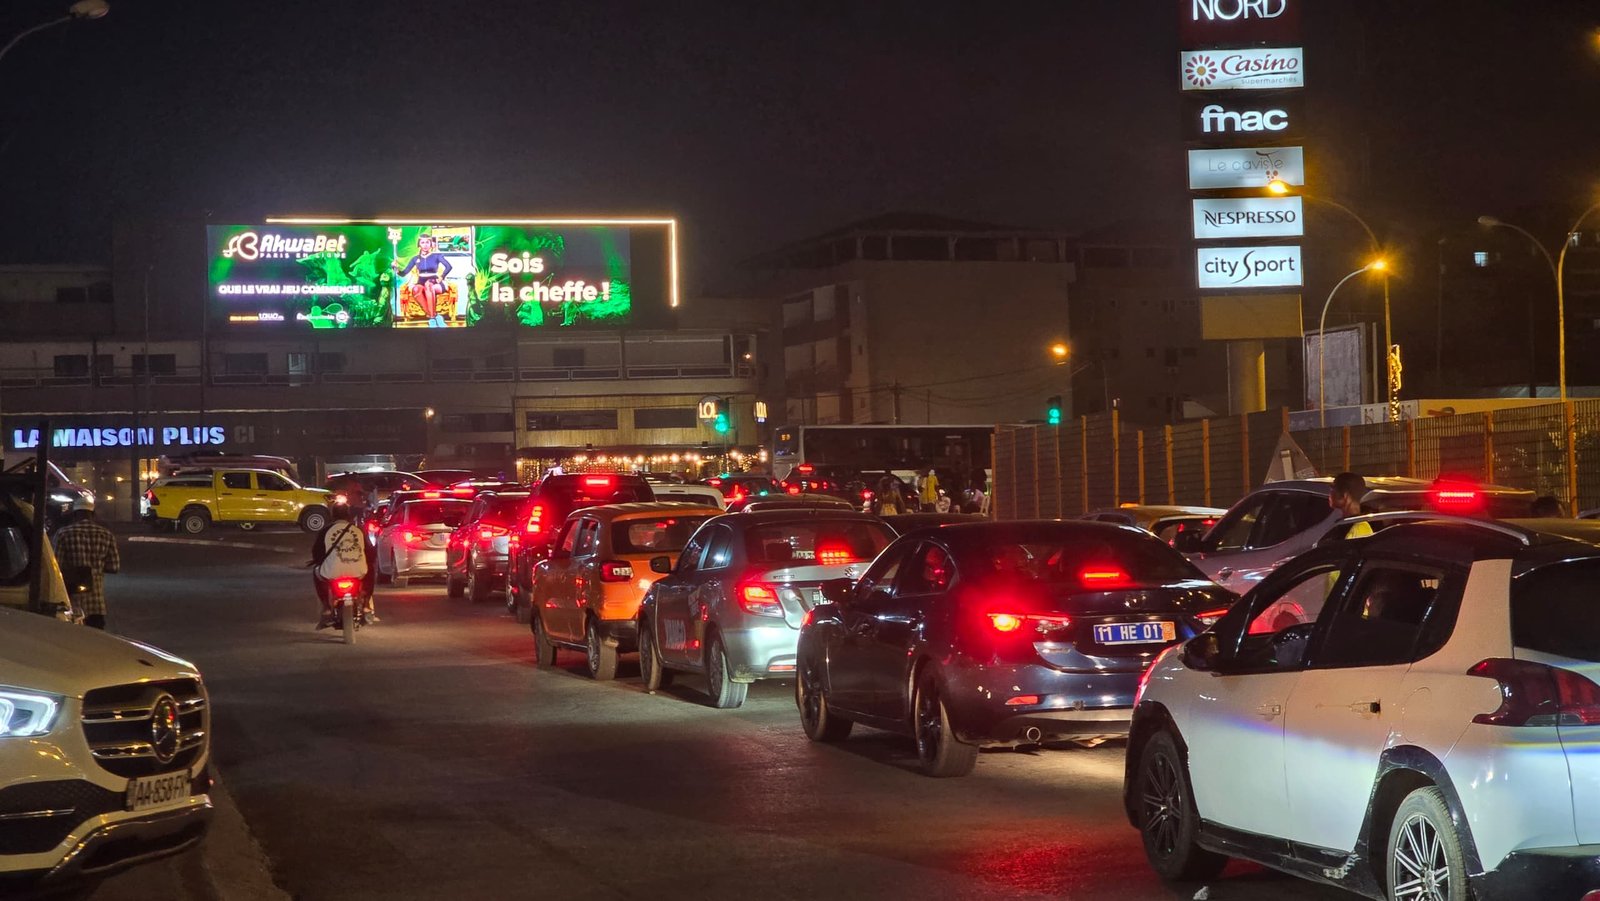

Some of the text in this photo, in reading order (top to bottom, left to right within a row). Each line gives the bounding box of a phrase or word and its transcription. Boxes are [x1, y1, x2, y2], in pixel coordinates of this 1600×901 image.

[1193, 0, 1286, 20] NORD
[1221, 54, 1298, 75] Casino
[1201, 104, 1288, 132] fnac
[1208, 159, 1226, 171] Le
[1202, 209, 1295, 227] NESPRESSO
[260, 235, 346, 253] AkwaBet
[491, 252, 543, 273] Sois
[218, 285, 241, 295] QUE
[242, 285, 256, 295] LE
[256, 285, 280, 295] VRAI
[281, 285, 300, 295] JEU
[492, 282, 514, 302] la
[520, 281, 597, 302] cheffe
[14, 429, 40, 448] LA
[53, 427, 154, 447] MAISON
[163, 426, 226, 445] PLUS
[1097, 626, 1113, 641] 11
[1120, 625, 1138, 640] HE
